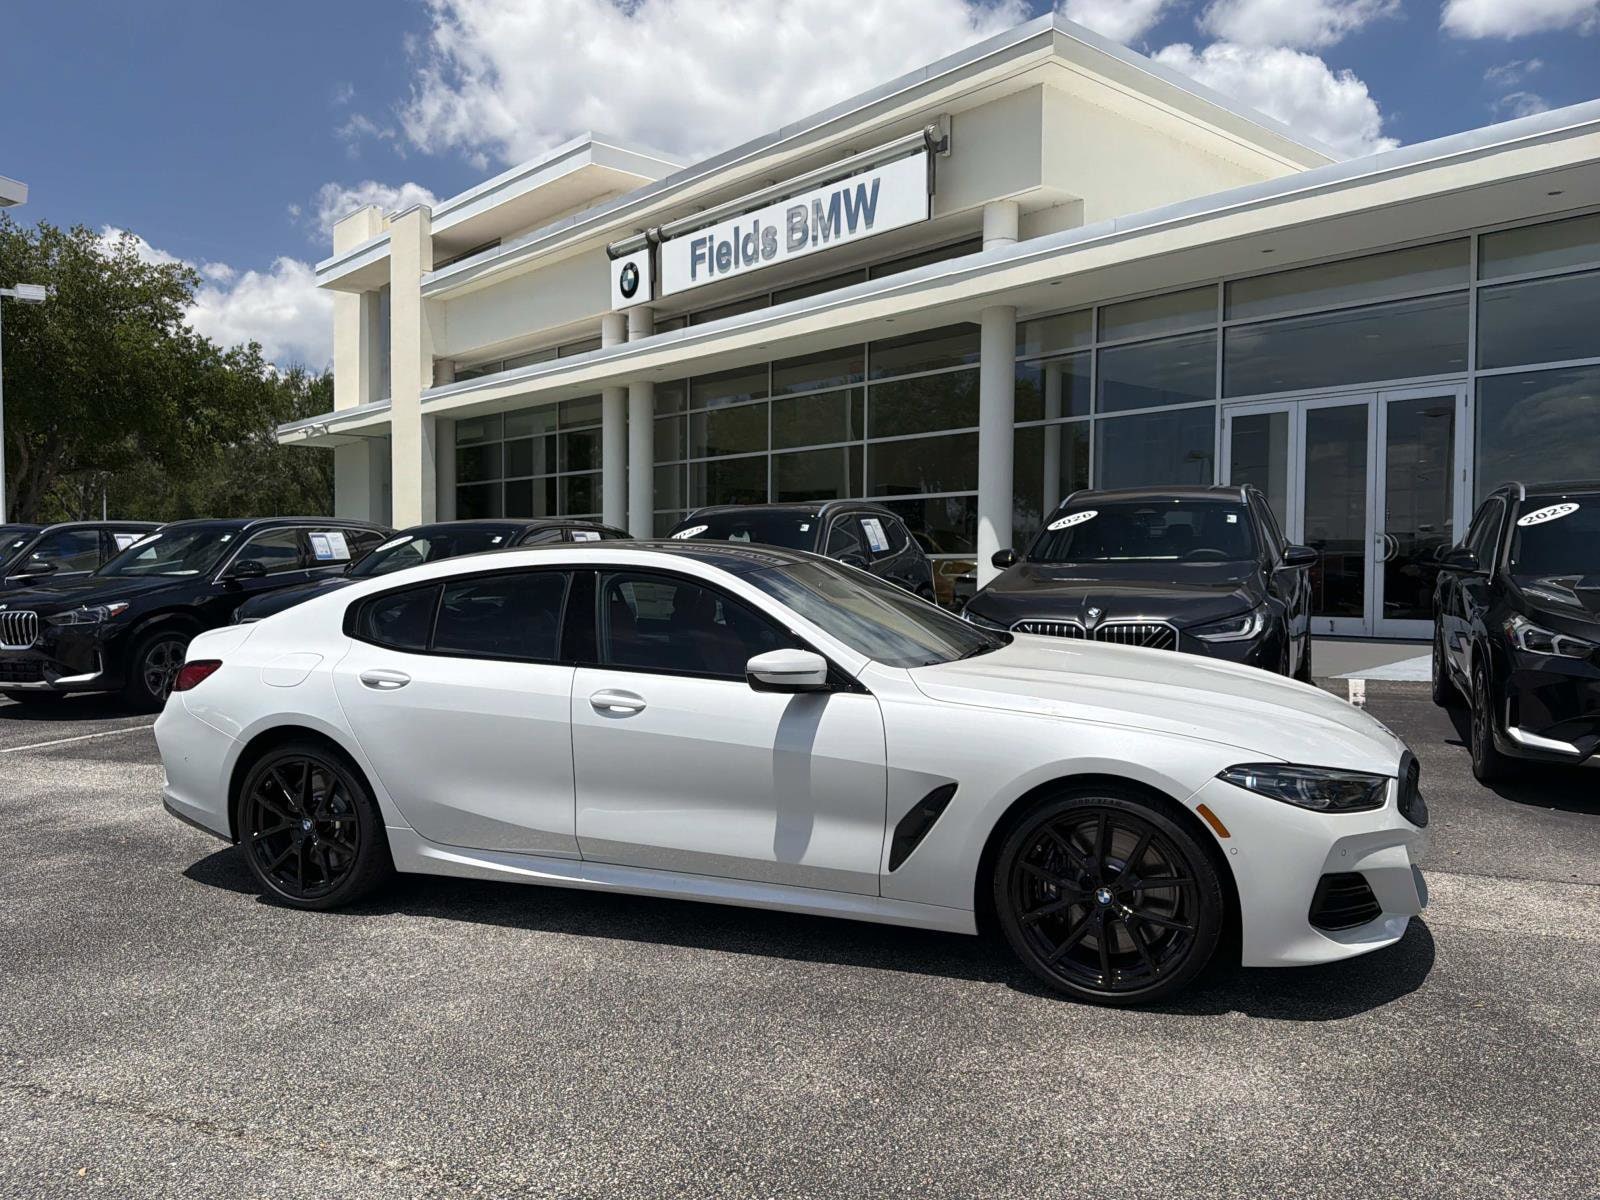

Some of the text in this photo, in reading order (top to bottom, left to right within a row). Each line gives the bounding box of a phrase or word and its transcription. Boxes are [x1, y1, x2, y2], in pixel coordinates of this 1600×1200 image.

[690, 177, 880, 281] Fields BMW
[1523, 504, 1572, 524] 2025
